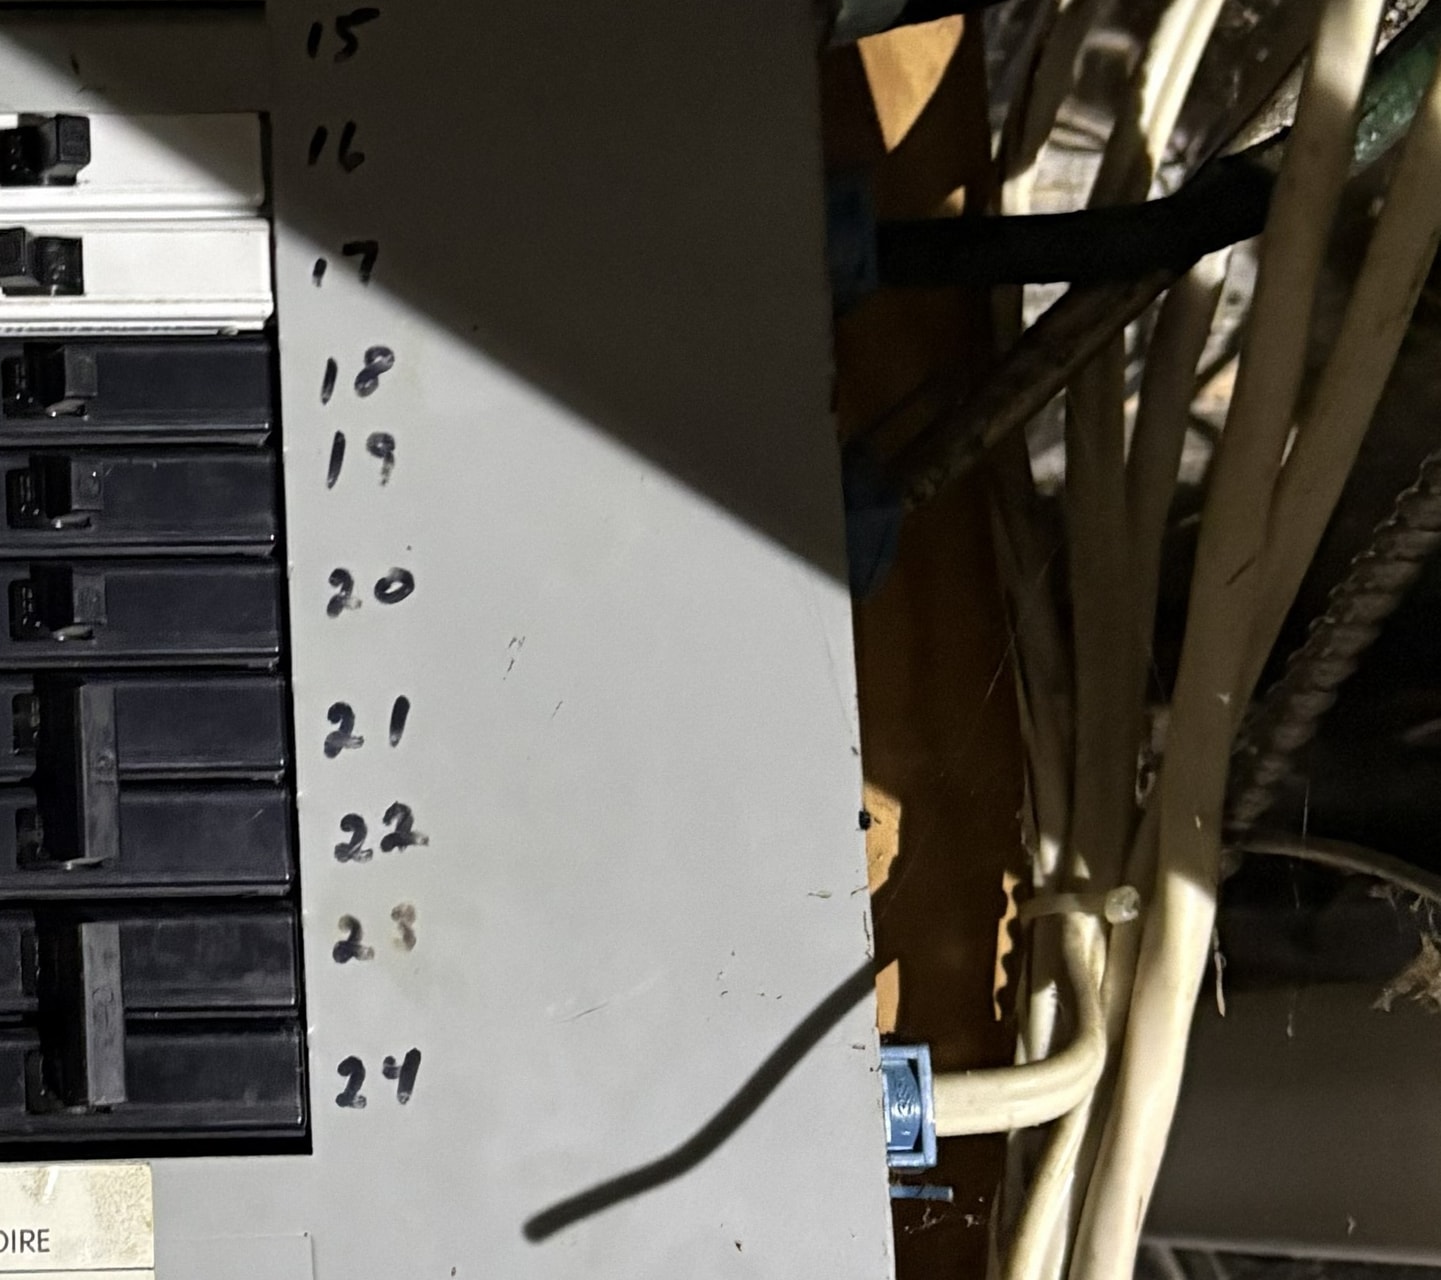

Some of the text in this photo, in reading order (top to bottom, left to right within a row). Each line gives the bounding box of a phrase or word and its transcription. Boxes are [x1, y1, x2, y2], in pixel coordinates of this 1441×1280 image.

[306, 8, 380, 63] 15
[308, 121, 365, 173] 16
[312, 239, 379, 289] 17
[321, 345, 395, 406] 18
[327, 430, 396, 491] 19
[326, 566, 415, 618] 20
[324, 695, 411, 759] 21
[334, 801, 429, 862] 22
[336, 1048, 422, 1109] 24
